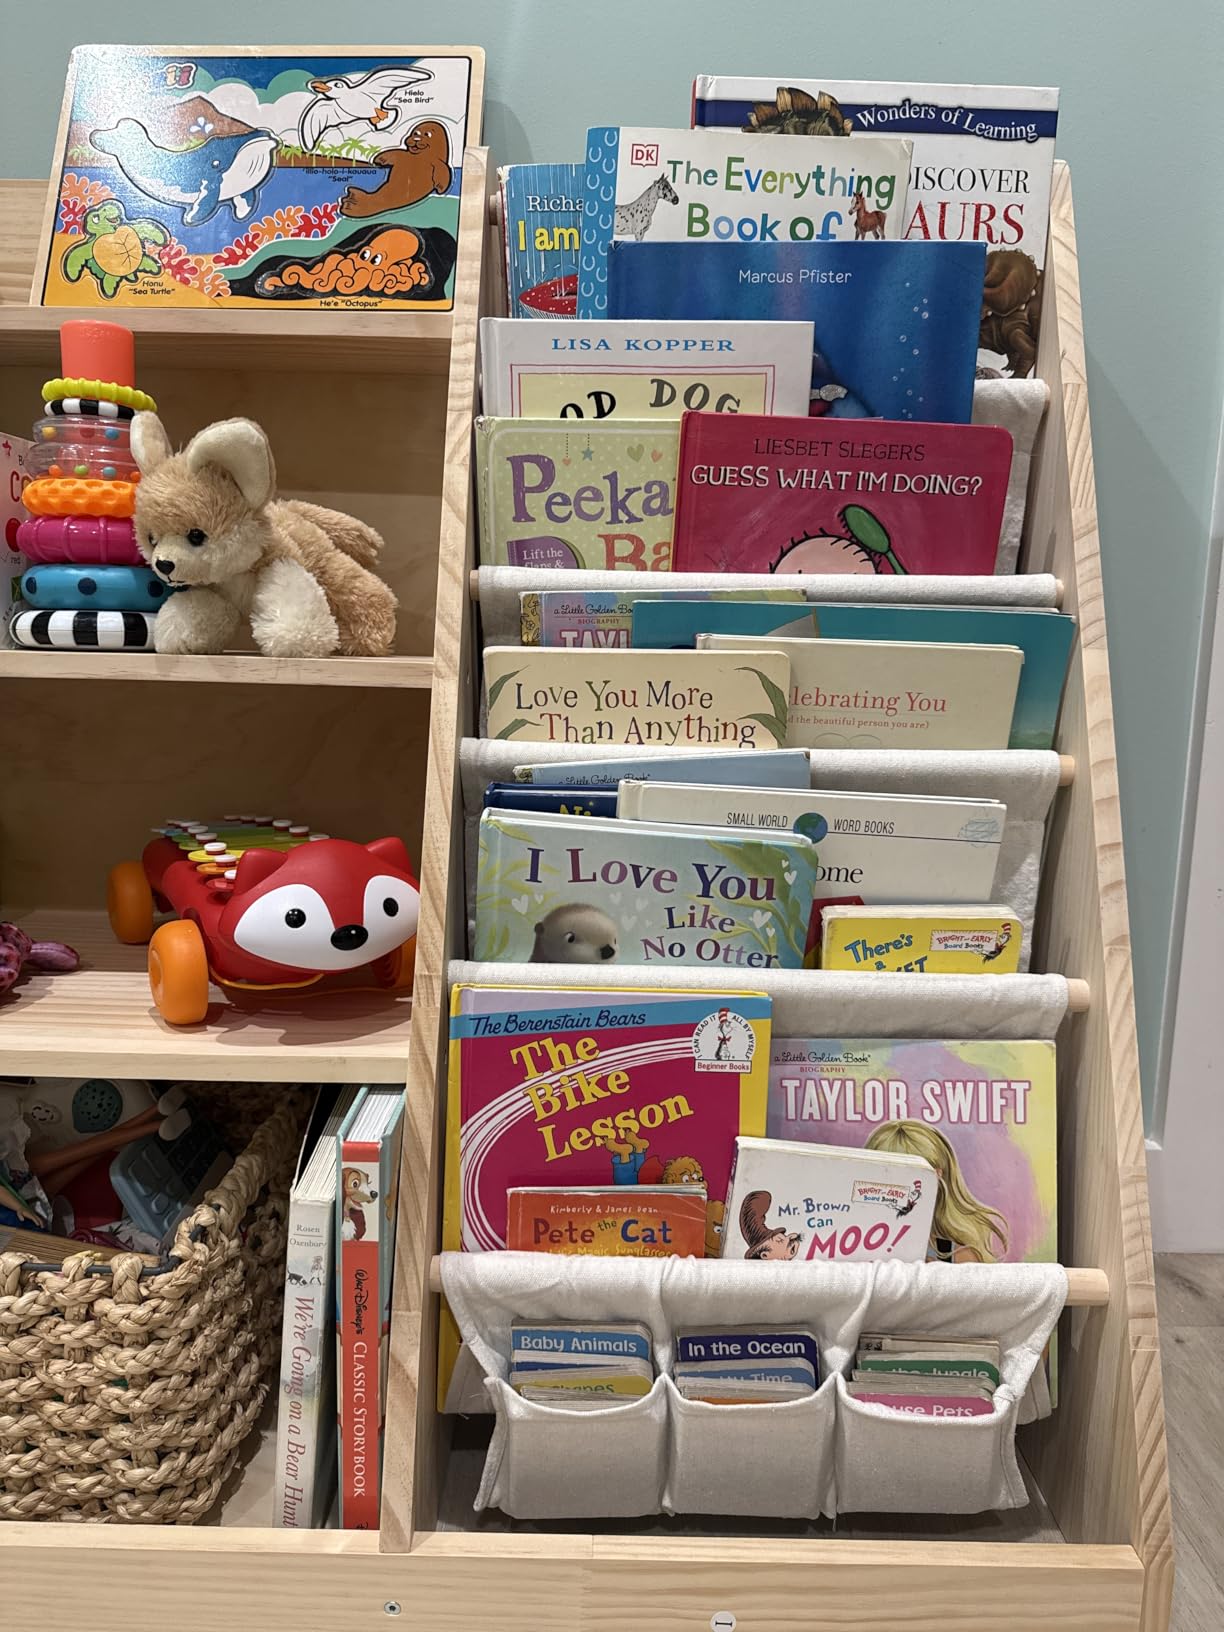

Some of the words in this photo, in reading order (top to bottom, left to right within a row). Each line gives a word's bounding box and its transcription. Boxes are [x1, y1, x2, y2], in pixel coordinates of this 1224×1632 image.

[856, 102, 936, 128] Wonders
[941, 108, 964, 125] of
[964, 113, 1038, 141] Learning
[635, 149, 655, 161] DK
[667, 160, 718, 186] The
[725, 156, 896, 210] Everything
[687, 203, 781, 240] Book
[789, 210, 843, 240] of
[518, 221, 526, 251] I
[534, 227, 580, 251] am
[739, 269, 793, 284] Marcus
[799, 269, 852, 284] Pfister
[341, 300, 382, 308] "Octopus"
[551, 338, 611, 351] LISA
[624, 339, 736, 352] KOPPER
[754, 438, 833, 457] LIESBET
[839, 441, 925, 461] SLEGERS
[506, 453, 674, 525] Peeka
[692, 464, 769, 487] GUESS
[777, 468, 852, 492] WHAT
[856, 471, 889, 493] I'M
[892, 473, 982, 497] DOING?
[523, 549, 544, 560] Lift
[545, 548, 563, 558] the
[561, 605, 584, 615] Little
[585, 604, 617, 615] Golden
[515, 683, 578, 710] Love
[585, 680, 639, 711] You
[646, 680, 713, 709] More
[789, 686, 900, 717] lebrating
[905, 691, 947, 712] You
[540, 712, 613, 744] Than
[624, 713, 756, 748] Anything
[796, 716, 811, 724] the
[813, 717, 855, 726] beautiful
[857, 720, 889, 728] person
[891, 722, 907, 730] you
[727, 812, 755, 826] SMALL
[758, 814, 788, 827] WORLD
[834, 818, 861, 832] WORD
[864, 820, 895, 834] BOOKS
[525, 847, 545, 884] I
[566, 847, 678, 894] Love
[692, 862, 776, 901] You
[664, 904, 736, 934] Like
[844, 933, 913, 964] There's
[936, 934, 965, 944] BRIGHT
[970, 935, 993, 943] EARLY
[640, 936, 686, 961] No
[695, 938, 779, 968] Otter
[874, 960, 886, 970] a
[469, 1016, 501, 1036] The
[503, 1012, 593, 1034] Berenstain
[596, 1009, 646, 1028] Bears
[695, 1020, 709, 1036] READ
[710, 1014, 717, 1022] IT
[732, 1015, 743, 1025] ALL
[743, 1023, 752, 1032] BY
[509, 1035, 601, 1081] The
[744, 1034, 755, 1060] MYSELF
[782, 1051, 806, 1062] Little
[808, 1051, 842, 1062] Golden
[843, 1052, 869, 1063] Book
[697, 1062, 728, 1070] Beginner
[522, 1067, 631, 1122] Bike
[781, 1079, 908, 1121] TAYLOR
[922, 1081, 1030, 1123] SWIFT
[537, 1092, 695, 1163] Lesson
[858, 1187, 882, 1195] BRIGHT
[550, 1205, 592, 1215] Kimberly
[595, 1205, 602, 1213] &
[604, 1205, 632, 1214] James
[637, 1205, 658, 1214] Dean
[778, 1204, 800, 1217] Mr.
[803, 1197, 850, 1213] Brown
[296, 1224, 320, 1232] Rosen
[533, 1218, 595, 1245] Pete
[598, 1218, 617, 1231] the
[620, 1218, 672, 1244] Cat
[807, 1217, 833, 1228] Can
[805, 1222, 911, 1261] MOO!
[293, 1296, 315, 1342] We're
[520, 1335, 564, 1352] Baby
[571, 1337, 637, 1353] Animals
[688, 1342, 705, 1357] In
[710, 1341, 741, 1356] the
[747, 1340, 806, 1355] Ocean
[284, 1345, 312, 1396] Going
[352, 1341, 368, 1404] CLASSIC
[750, 1373, 792, 1383] Time
[288, 1401, 302, 1422] on
[932, 1404, 973, 1417] Pets
[287, 1423, 301, 1435] a
[286, 1438, 306, 1486] Bear
[282, 1486, 304, 1528] Hunt
